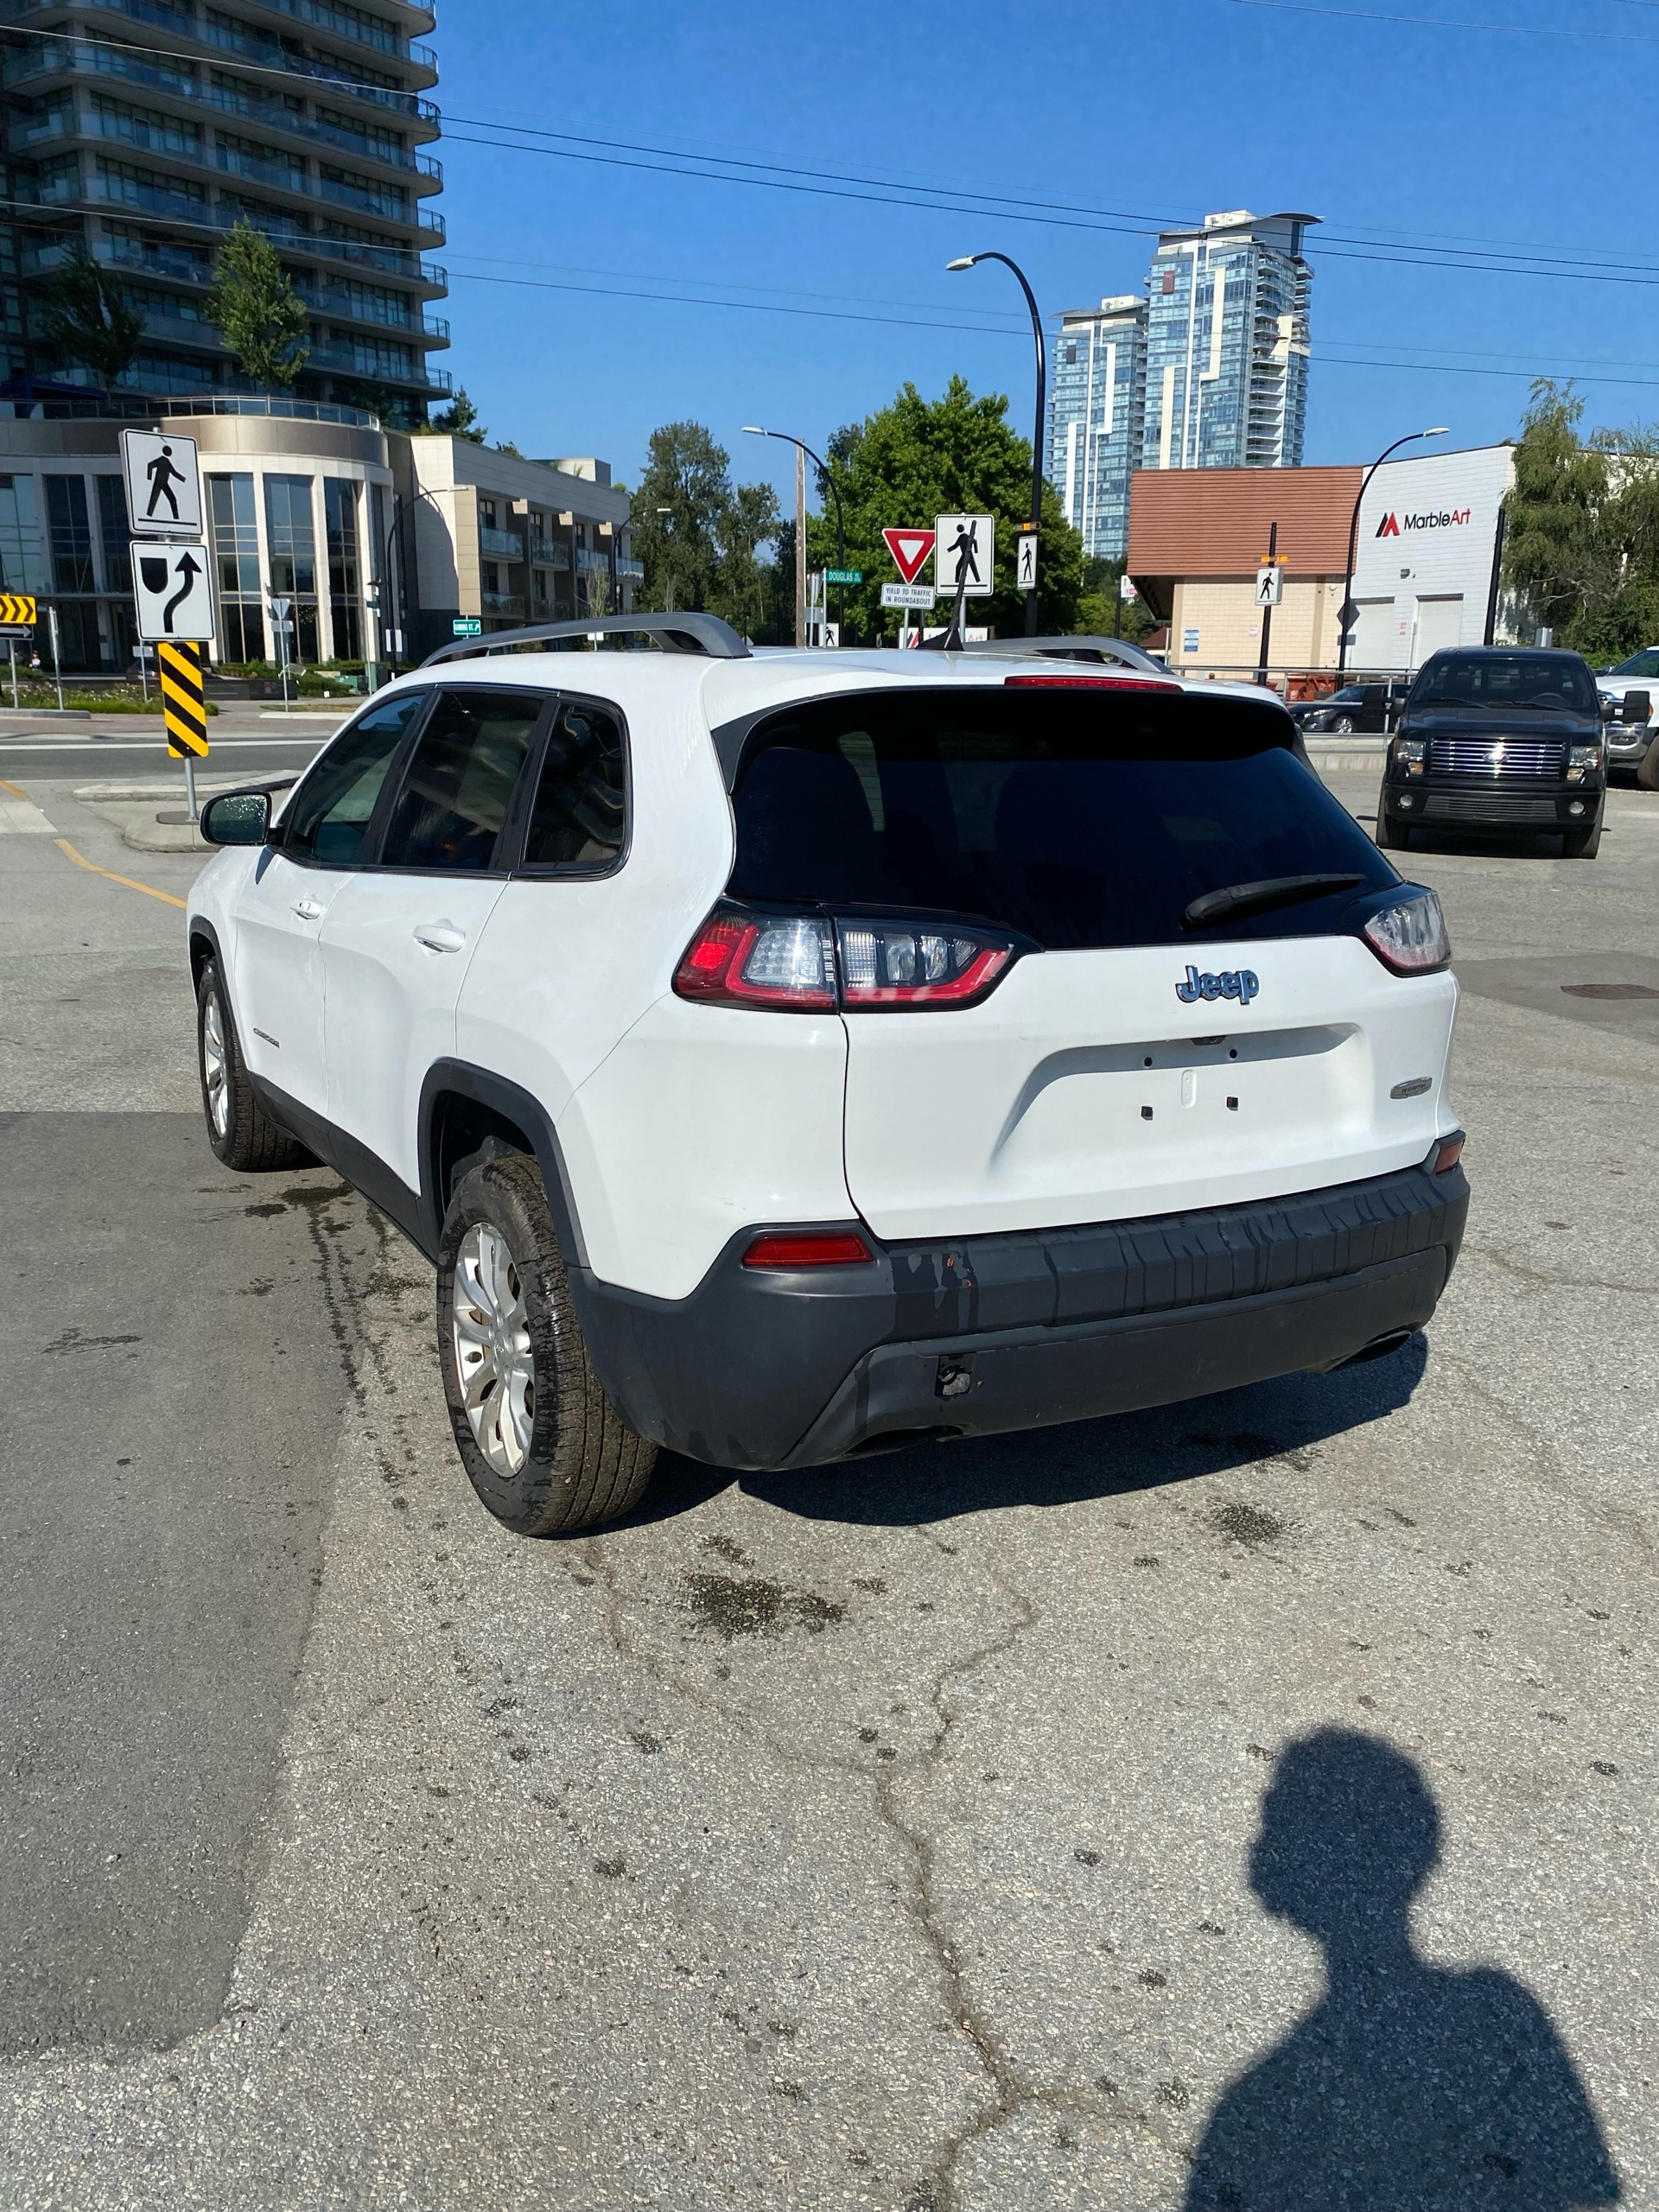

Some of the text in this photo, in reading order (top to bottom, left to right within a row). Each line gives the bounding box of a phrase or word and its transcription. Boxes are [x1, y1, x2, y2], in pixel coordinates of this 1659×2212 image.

[1404, 508, 1471, 531] MarbleArt
[829, 571, 854, 582] DOUGLAS
[893, 596, 931, 606] ROUNDABOUT
[1174, 964, 1260, 1005] Jeep
[1402, 1083, 1426, 1093] NORTH
